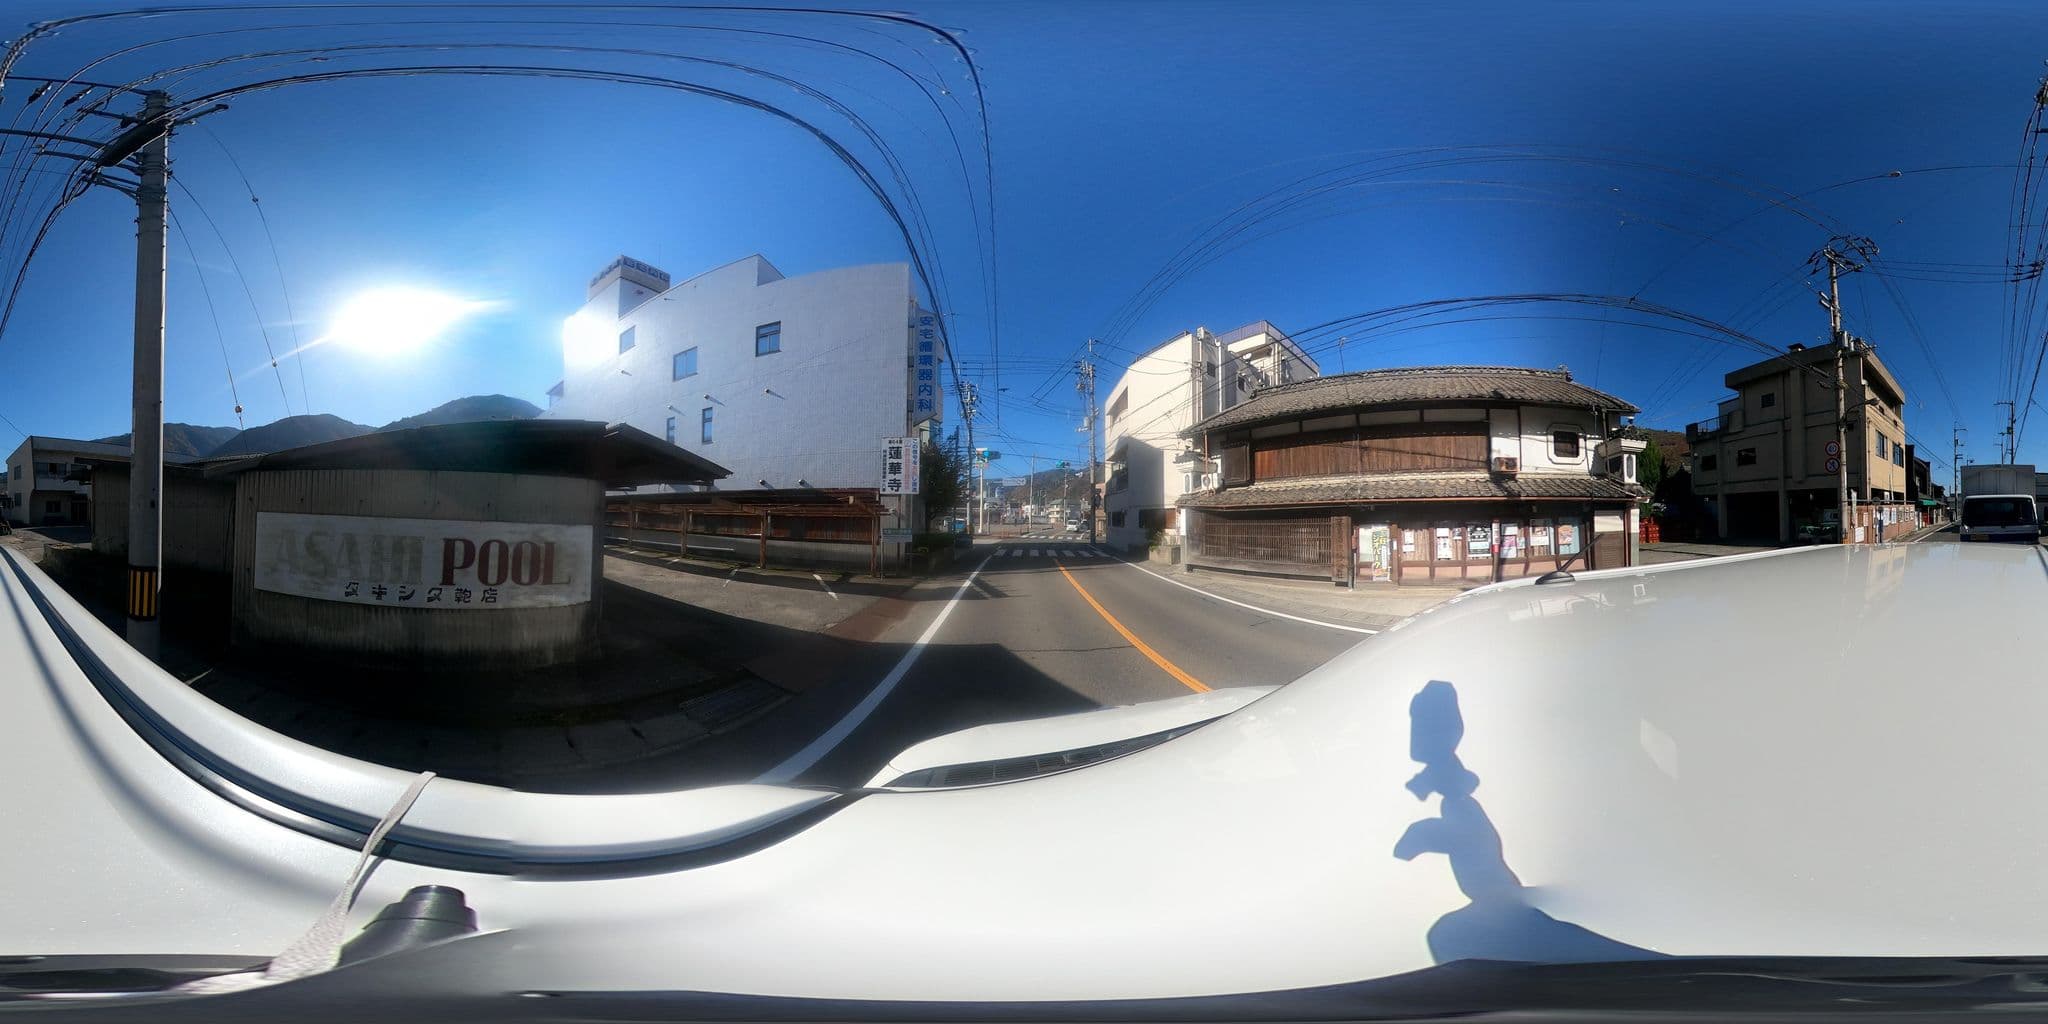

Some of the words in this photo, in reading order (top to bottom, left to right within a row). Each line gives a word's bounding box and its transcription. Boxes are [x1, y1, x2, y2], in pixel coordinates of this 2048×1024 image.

[918, 316, 934, 412] 安宅循環器内科
[888, 446, 902, 492] 蓮華寺
[440, 537, 572, 586] POOL
